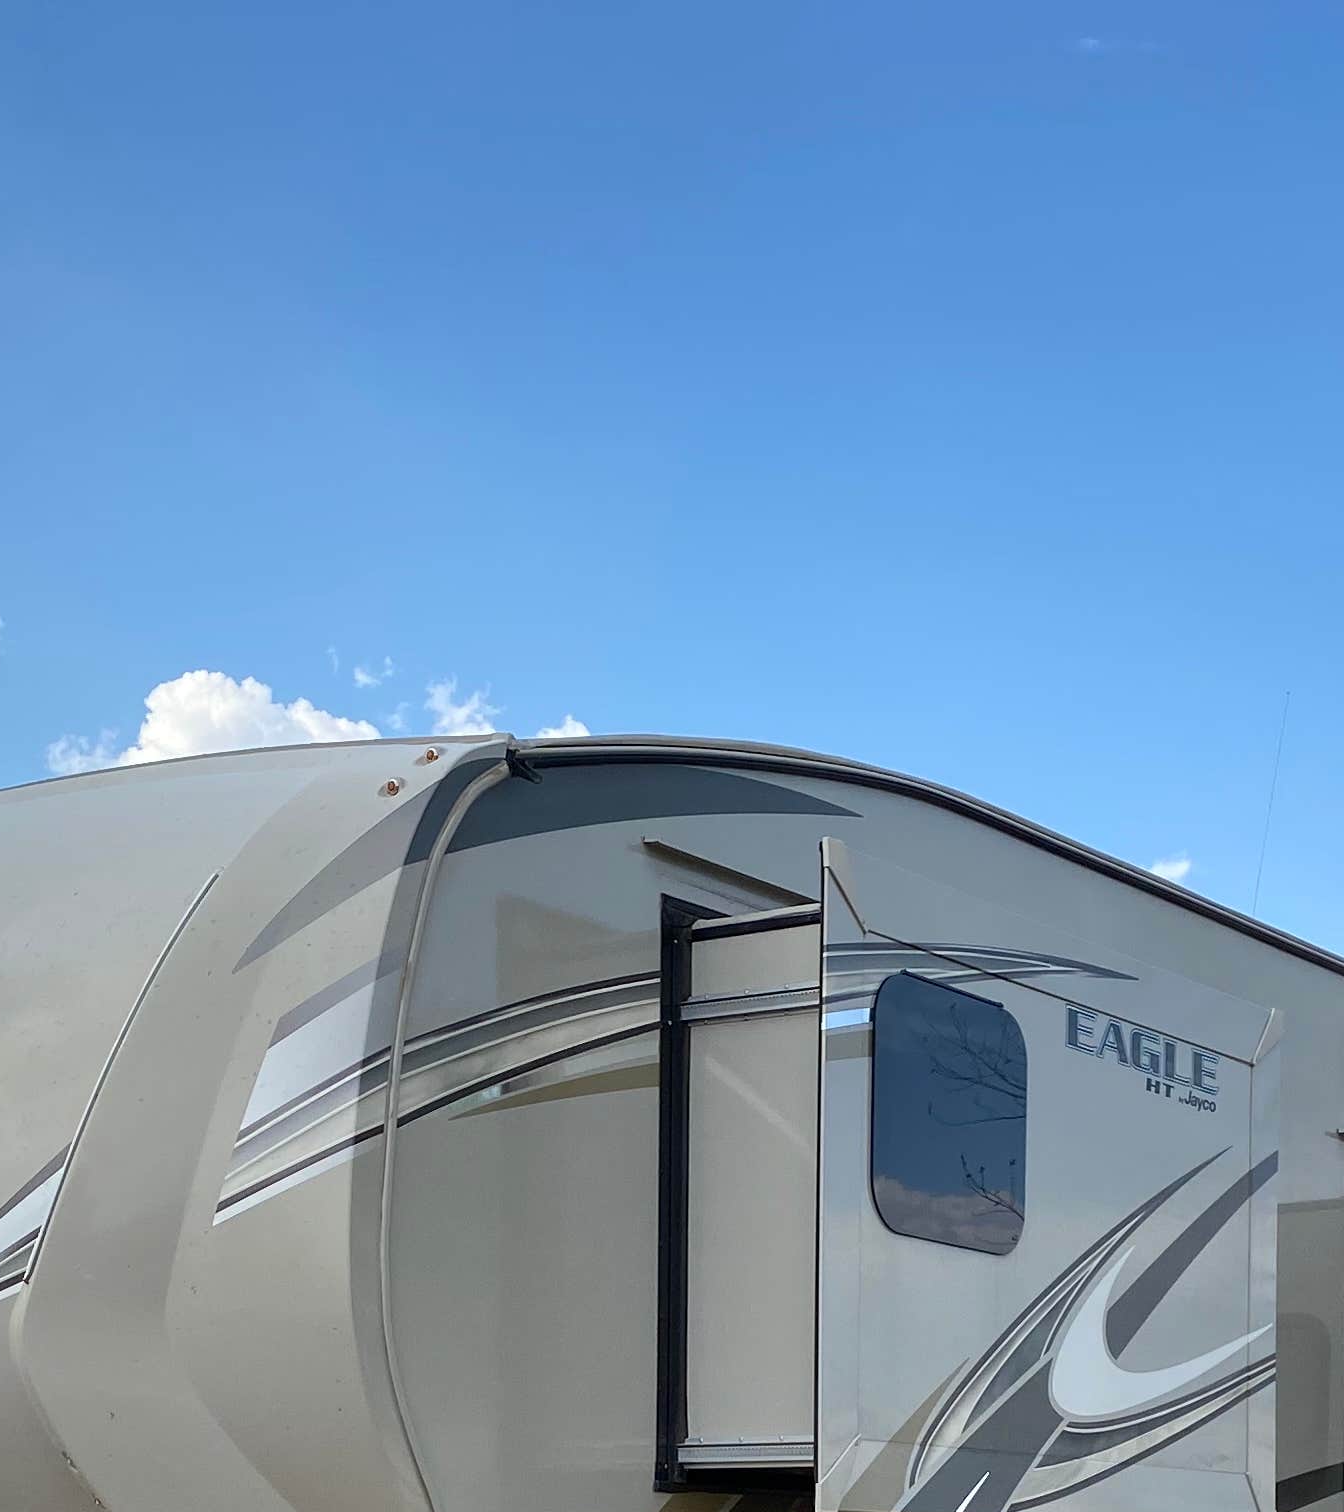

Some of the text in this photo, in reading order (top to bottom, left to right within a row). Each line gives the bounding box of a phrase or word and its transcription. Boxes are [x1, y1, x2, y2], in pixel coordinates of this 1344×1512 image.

[1065, 1003, 1220, 1096] EAGLE
[1146, 1078, 1174, 1097] HT
[1184, 1090, 1217, 1112] Jayco
